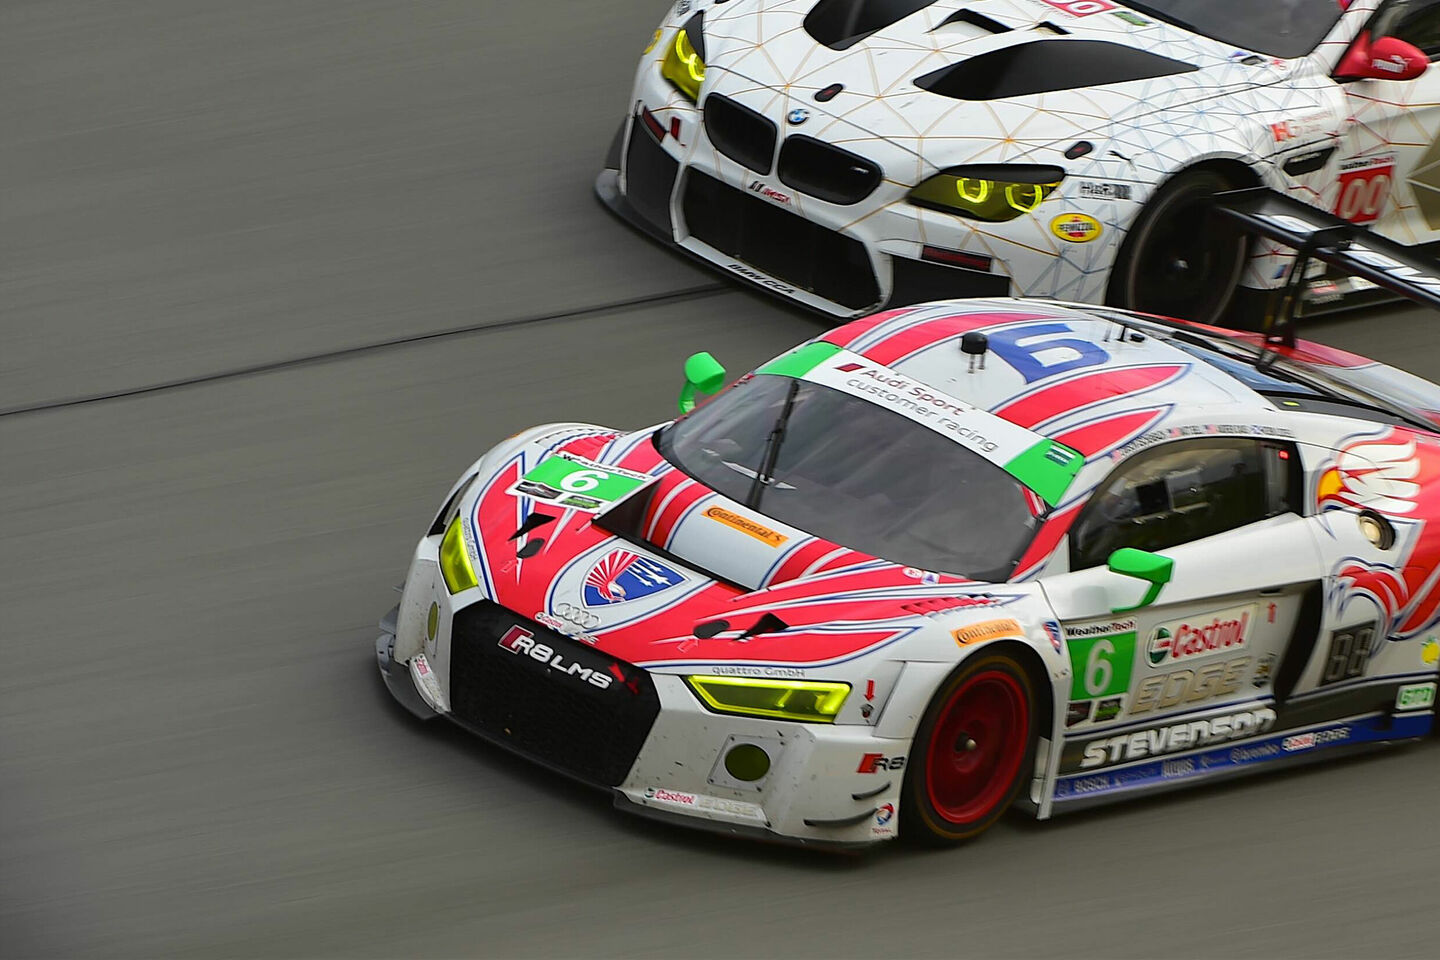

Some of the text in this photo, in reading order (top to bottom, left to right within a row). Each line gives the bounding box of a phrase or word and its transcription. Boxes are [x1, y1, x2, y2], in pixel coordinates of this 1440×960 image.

[728, 263, 796, 295] BMW CCA
[987, 323, 1111, 384] 6
[846, 378, 1000, 453] customer racing
[861, 369, 966, 417] Audi Sport
[559, 469, 610, 493] 6
[706, 506, 775, 539] Continental
[1171, 611, 1250, 658] Castrol
[508, 632, 555, 664] R8
[549, 654, 614, 690] LMS
[711, 665, 806, 678] quattro GmbH
[1084, 638, 1116, 697] 6
[1129, 655, 1253, 715] EDGE
[1079, 707, 1277, 768] STEVENSON
[866, 754, 906, 773] R8
